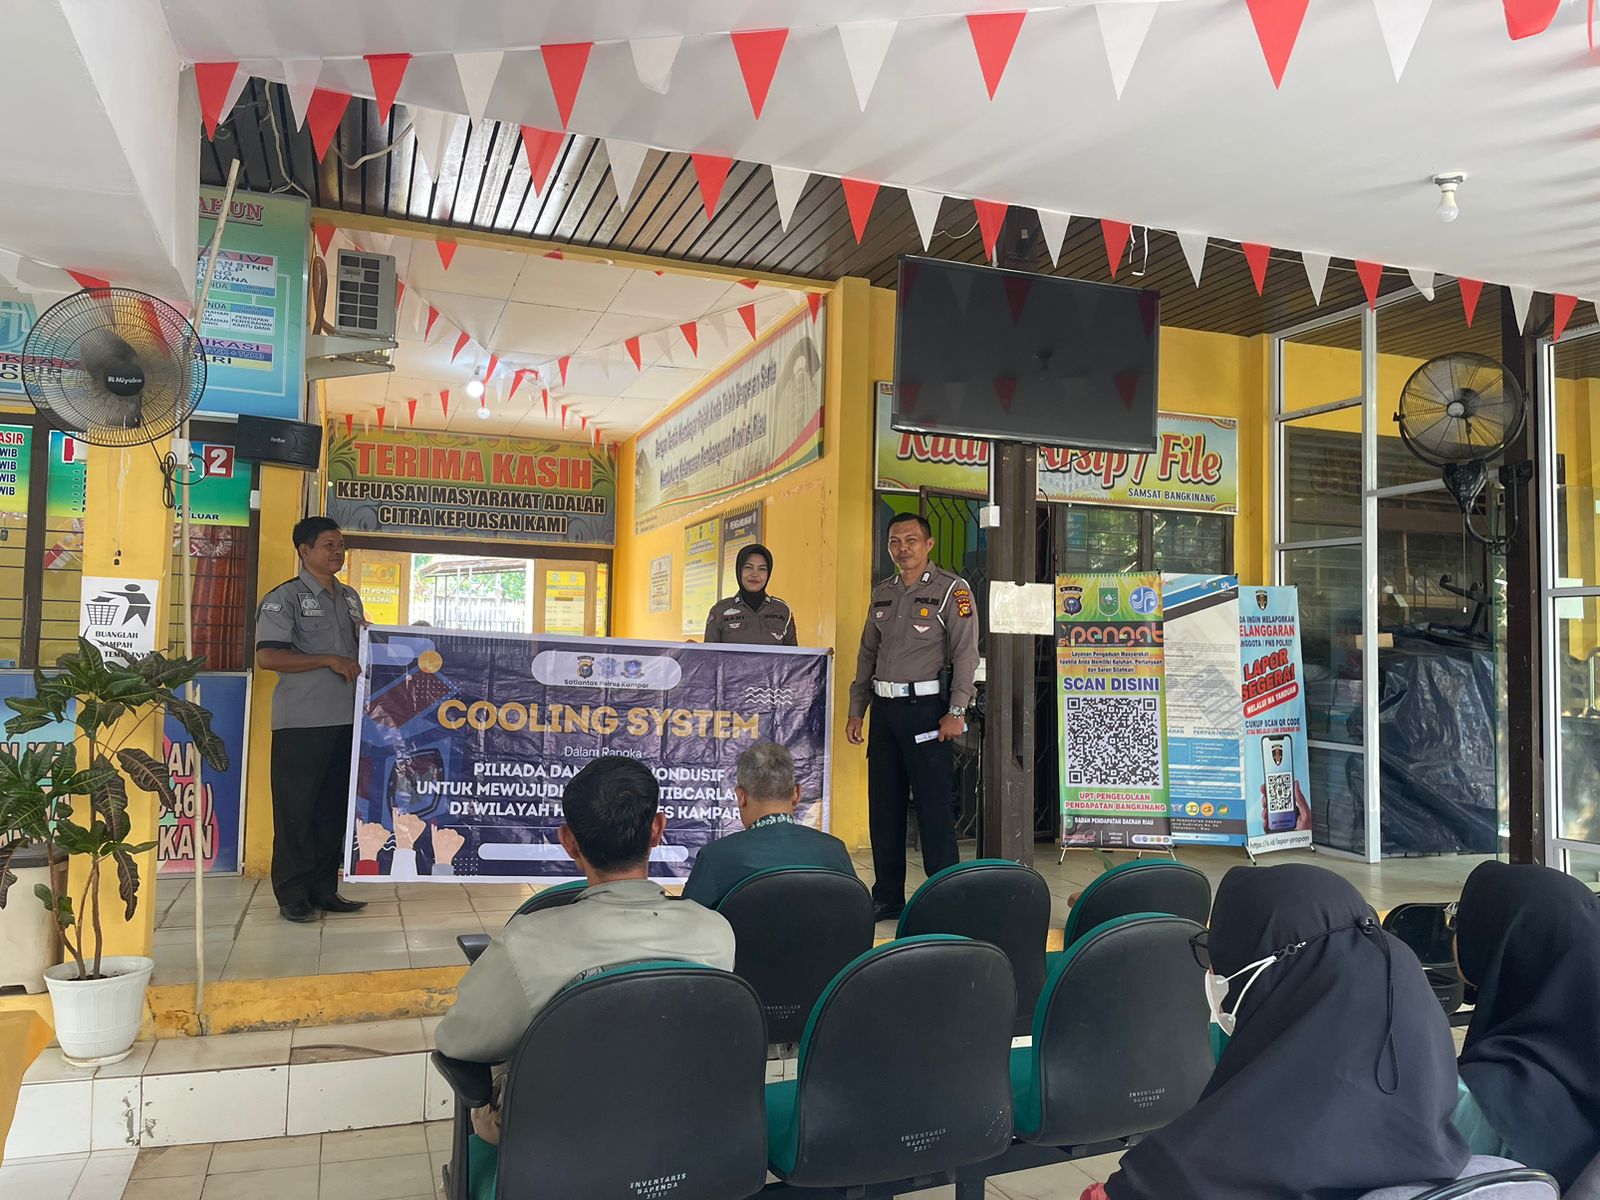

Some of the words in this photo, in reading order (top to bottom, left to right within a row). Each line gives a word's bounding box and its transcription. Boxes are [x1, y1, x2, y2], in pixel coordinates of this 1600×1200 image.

[210, 448, 228, 475] 2
[1158, 432, 1225, 484] File
[353, 441, 485, 484] TERIMA
[492, 452, 594, 491] KASIH
[337, 481, 429, 503] KEPUASAN
[431, 487, 543, 510] MASYARAKAT
[543, 494, 606, 514] ADALAH
[1128, 487, 1162, 499] SAMSAT
[1164, 490, 1217, 503] BANGKINANG
[176, 512, 220, 521] KLUAR
[379, 506, 432, 527] CITRA
[434, 508, 523, 531] KEPUASAN
[524, 515, 568, 534] KAMI
[1261, 615, 1295, 623] MELAPORKAN
[95, 630, 139, 639] BUANGLAH
[1093, 651, 1120, 659] Pengaduan
[1243, 648, 1289, 681] LAPOR
[621, 681, 649, 690] Kampar
[1063, 677, 1106, 691] SCAN
[1111, 677, 1160, 691] DISINI
[1241, 664, 1296, 703] SEGERA!
[437, 699, 619, 736] COOLING
[626, 707, 760, 739] SYSTEM
[1244, 719, 1264, 729] CUKUP
[564, 745, 599, 758] Dalam
[473, 762, 547, 778] PILKADA
[416, 781, 473, 796] UNTUK
[1079, 792, 1095, 801] UPT
[1096, 792, 1151, 802] PENGELOLAAN
[450, 801, 469, 815] DI
[473, 801, 550, 817] WILAYAH
[1065, 801, 1115, 811] PENDAPATAN
[1115, 803, 1167, 812] BANGKINANG
[1091, 817, 1122, 825] PENDAPATAN
[1122, 818, 1142, 826] DAERAH
[901, 1128, 947, 1142] INVENTARIS
[906, 1136, 940, 1147] BAPENDA
[629, 1172, 687, 1190] INVENTARIS
[636, 1182, 679, 1196] BAPENDA
